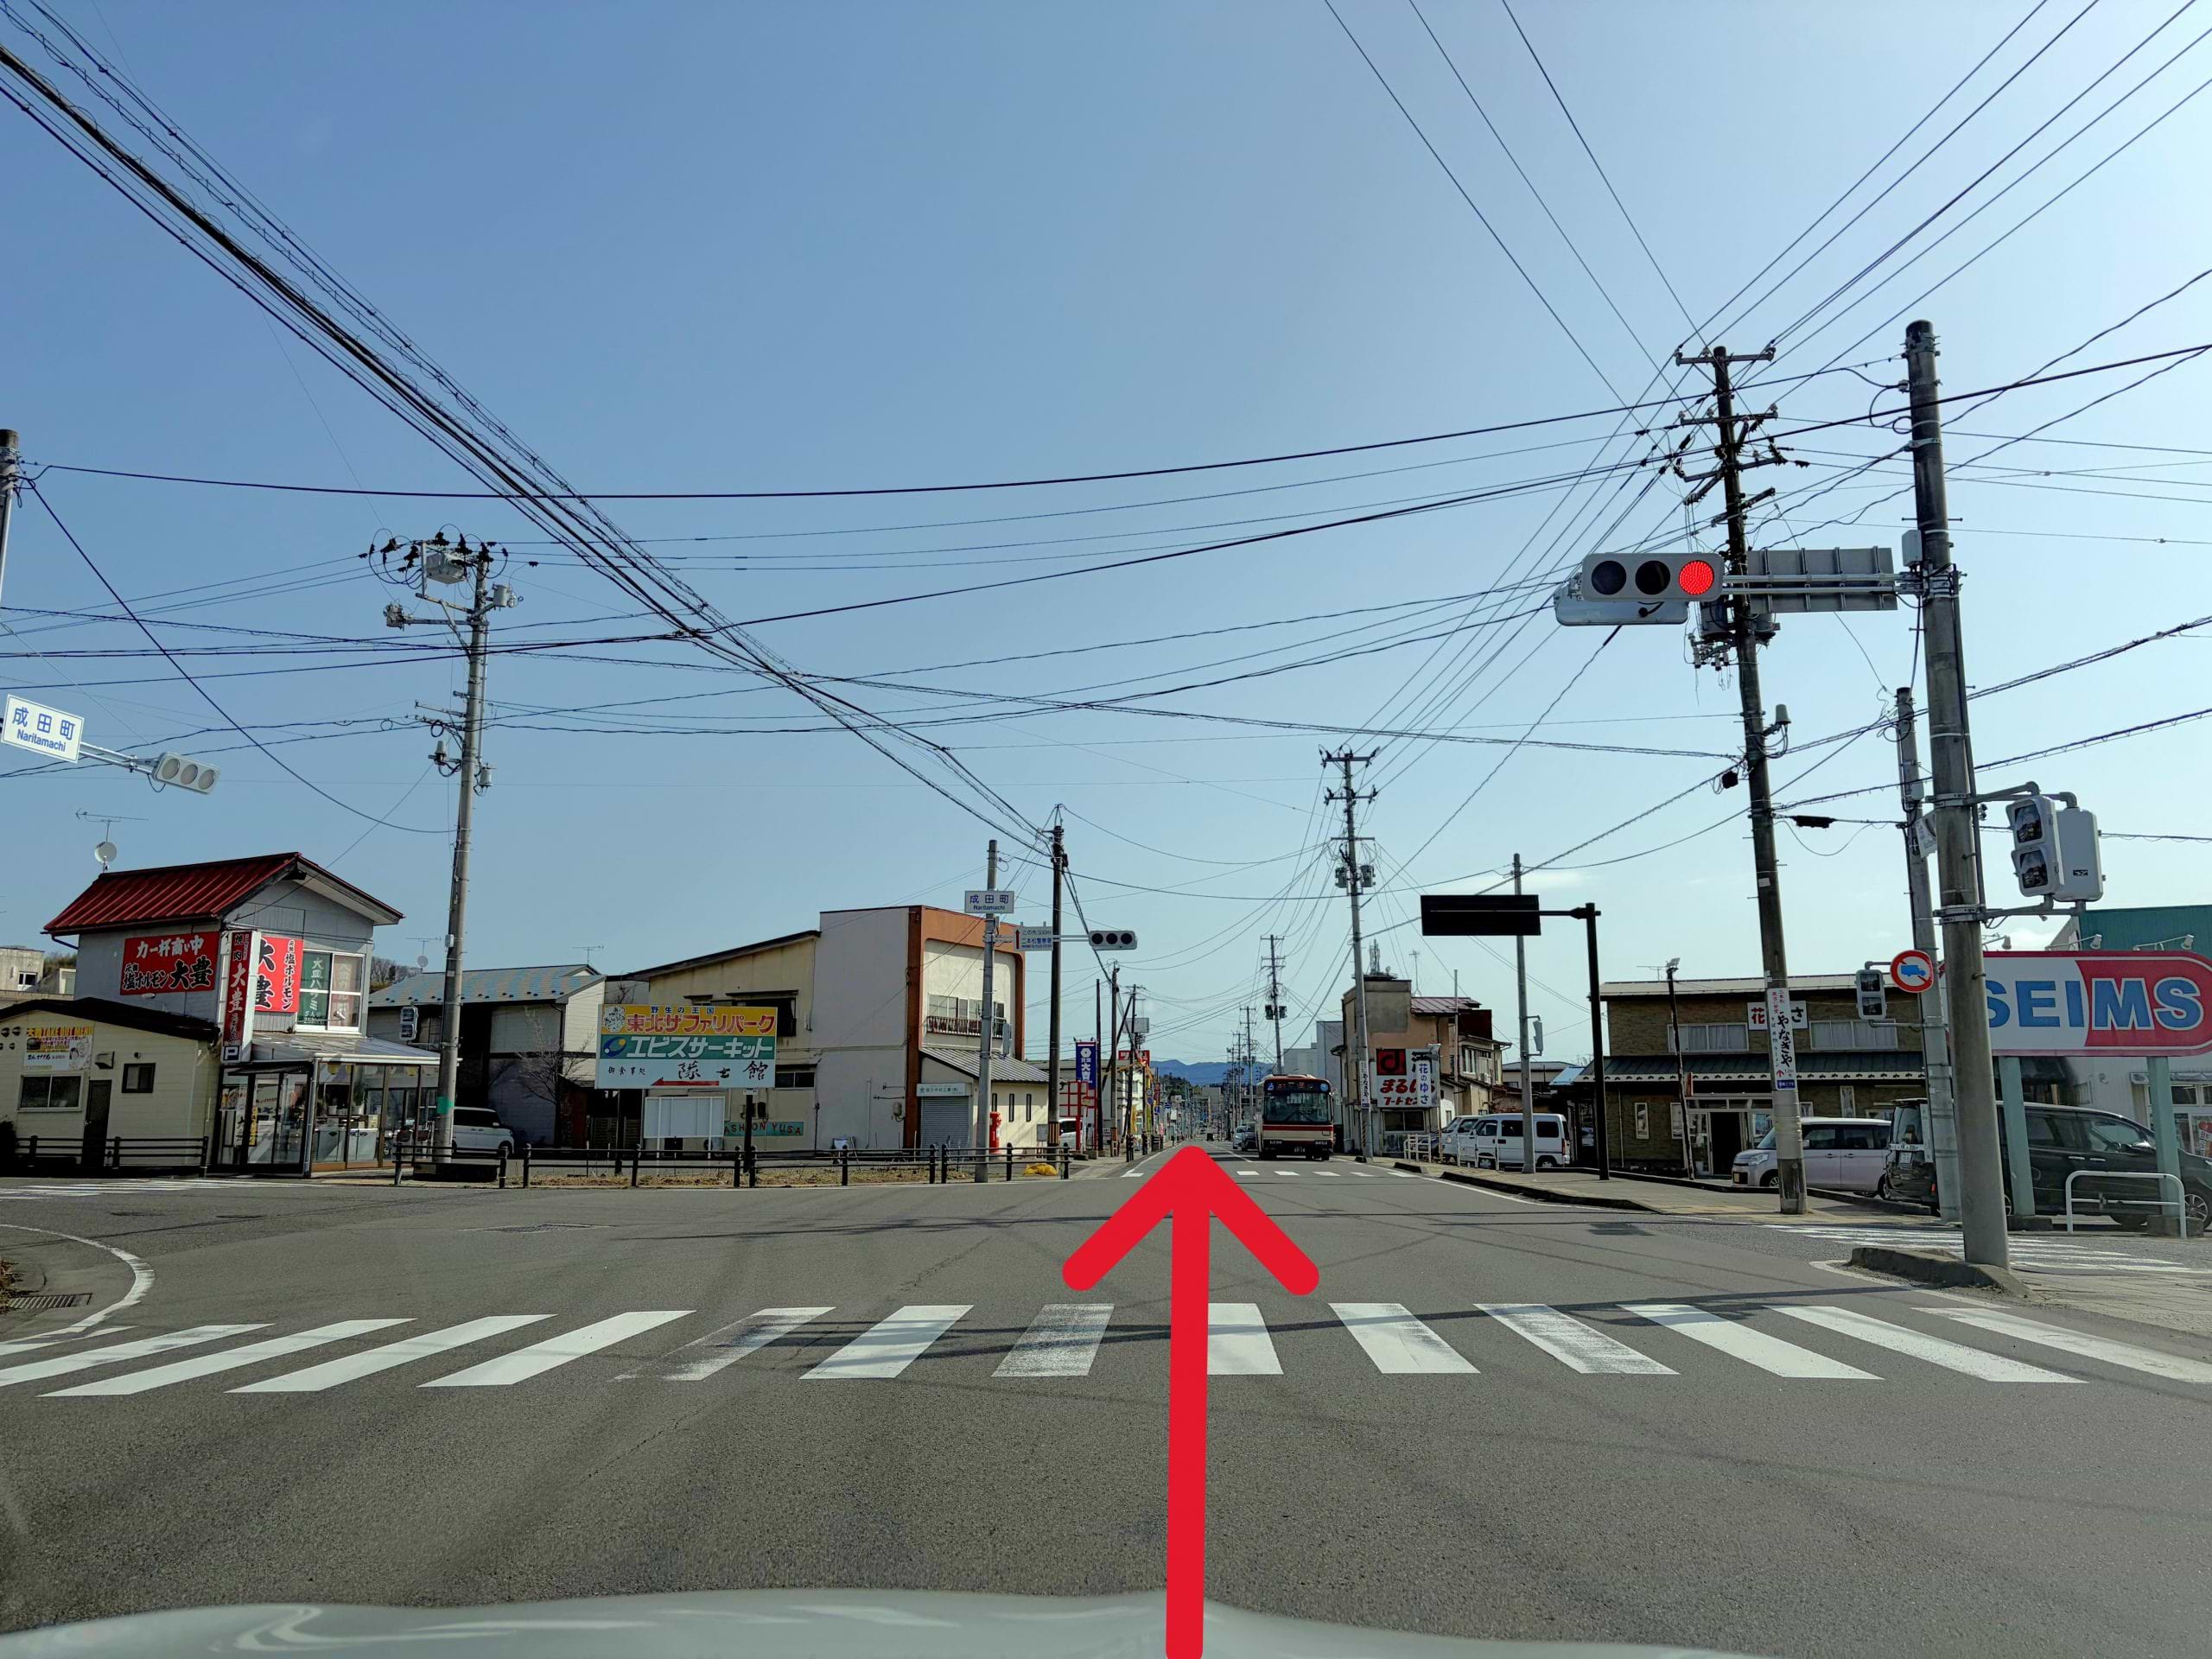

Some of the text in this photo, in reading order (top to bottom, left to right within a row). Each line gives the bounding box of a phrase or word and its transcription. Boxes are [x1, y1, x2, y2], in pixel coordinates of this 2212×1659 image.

[12, 706, 75, 741] 成田町
[16, 728, 67, 752] Naritamachi
[969, 894, 1009, 904] 成田町
[169, 955, 214, 989] 大豊
[228, 963, 248, 1014] 大豊
[283, 953, 296, 1010] 塩ホルモン
[1985, 977, 2204, 1031] SEIMS
[626, 1014, 775, 1034] 東北サファリパーク
[626, 1036, 774, 1058] エビスサーキット
[1419, 1063, 1429, 1104] 花のゆさ
[772, 1122, 801, 1135] YUSA
